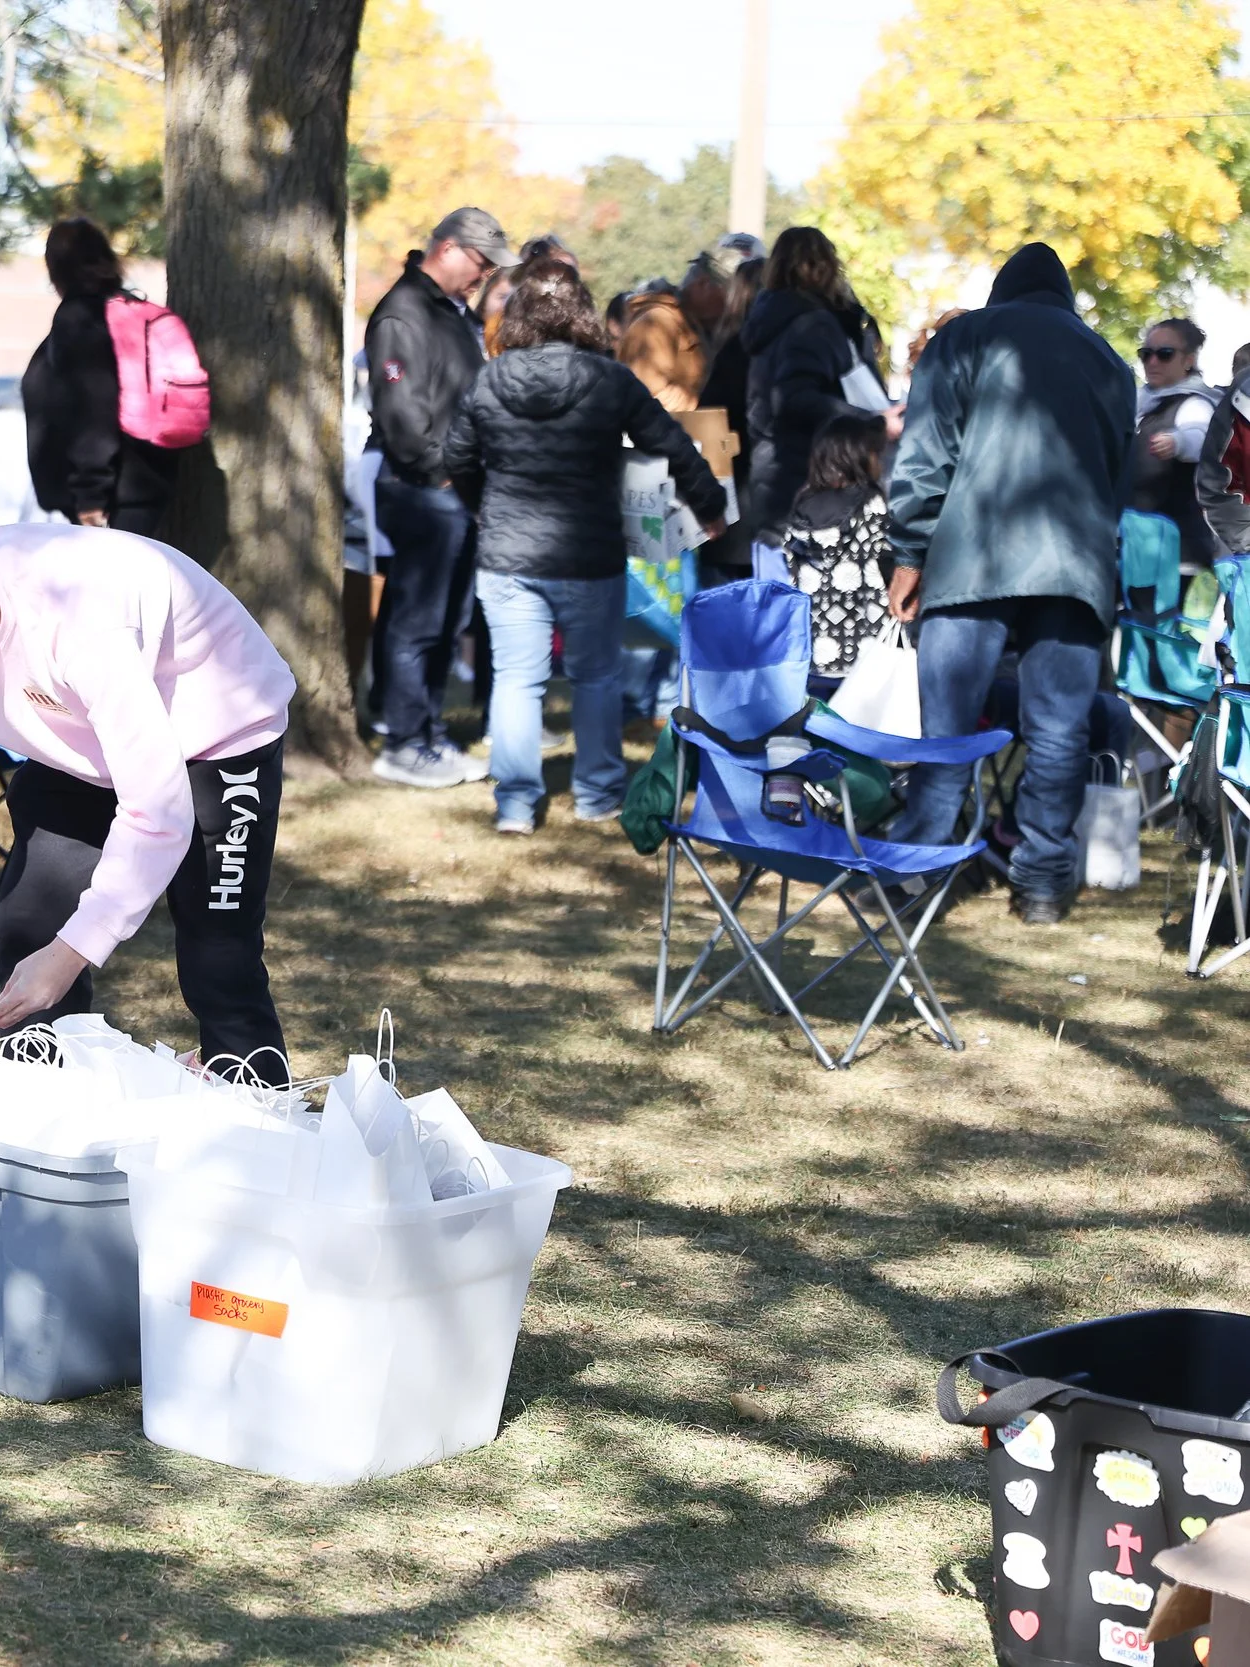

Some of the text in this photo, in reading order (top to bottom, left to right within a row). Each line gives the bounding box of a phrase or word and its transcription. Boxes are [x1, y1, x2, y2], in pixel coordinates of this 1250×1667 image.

[208, 803, 258, 910] Hurley
[196, 1286, 265, 1313] Plastic grocery
